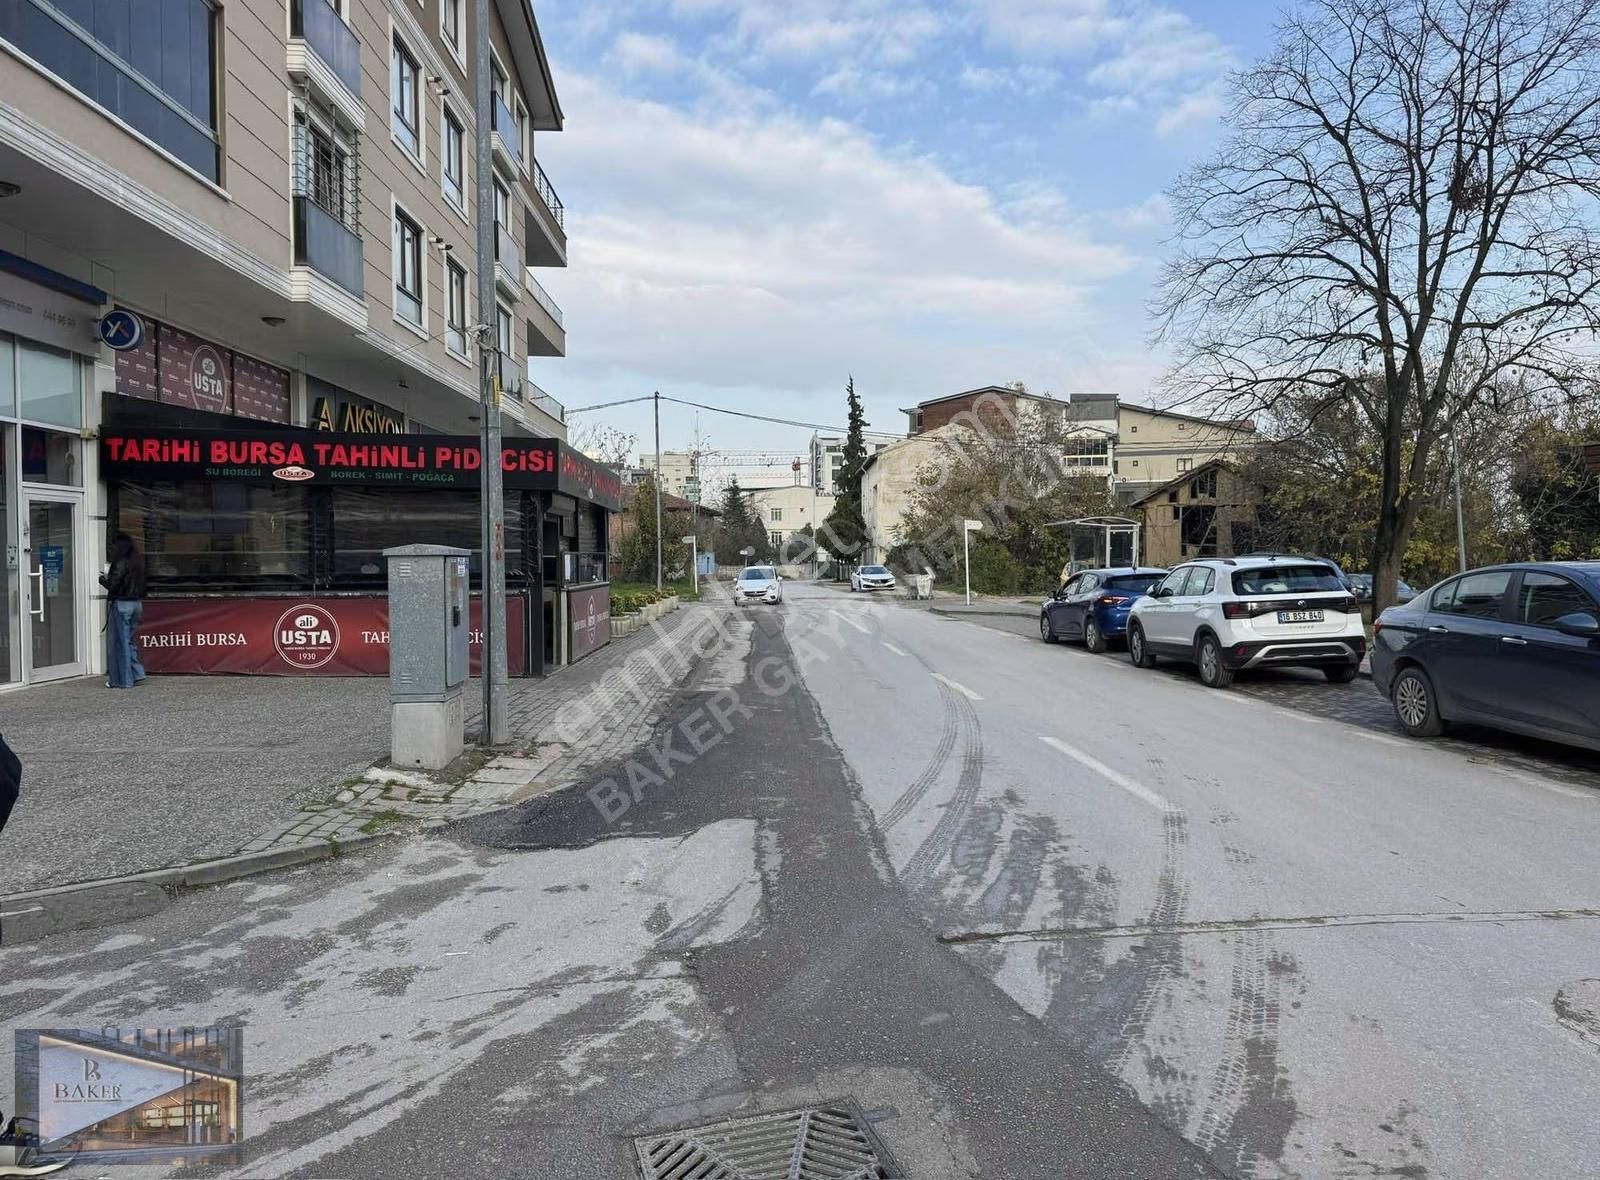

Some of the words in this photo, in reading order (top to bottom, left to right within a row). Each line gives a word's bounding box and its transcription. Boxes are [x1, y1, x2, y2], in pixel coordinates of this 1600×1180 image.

[194, 372, 223, 396] USTA
[344, 401, 404, 434] AKSİYON
[210, 440, 305, 465] BURSA
[299, 616, 313, 627] ali
[1282, 612, 1290, 621] 16
[140, 631, 192, 648] TARİHİ
[197, 633, 248, 647] BURSA
[281, 630, 332, 645] USTA
[299, 652, 317, 661] 1930
